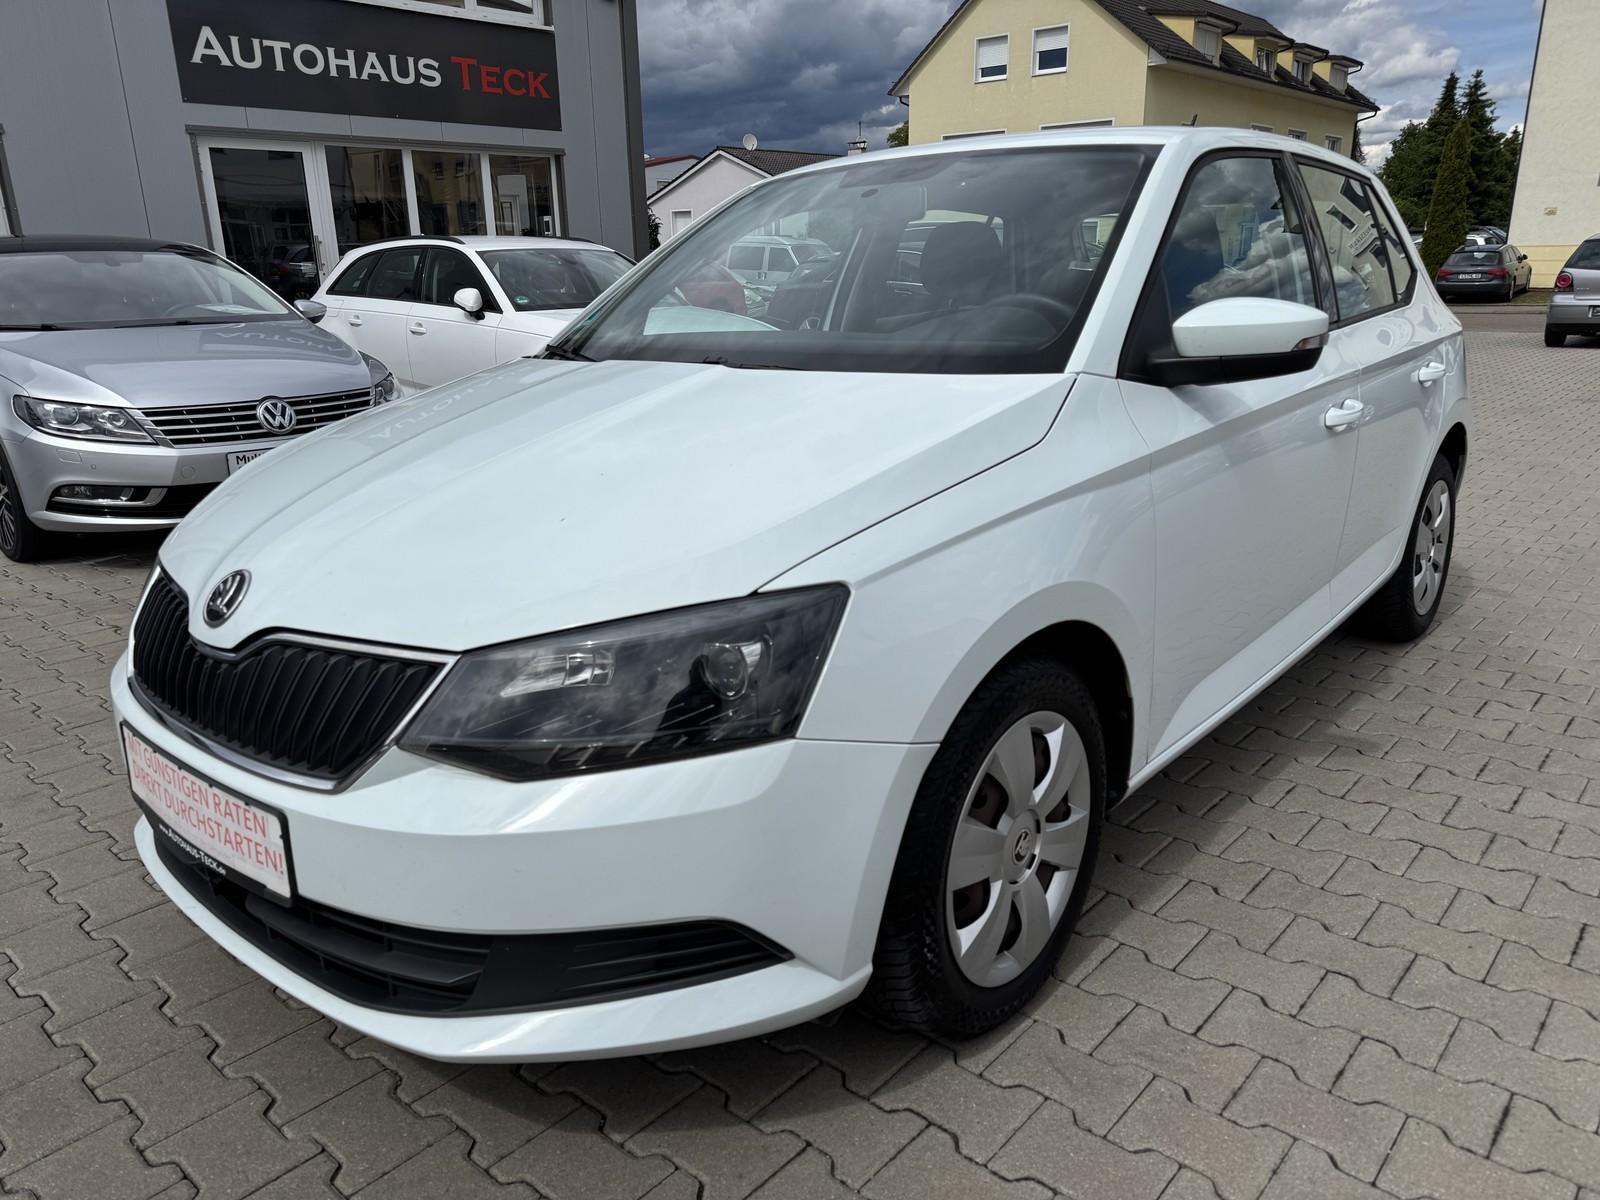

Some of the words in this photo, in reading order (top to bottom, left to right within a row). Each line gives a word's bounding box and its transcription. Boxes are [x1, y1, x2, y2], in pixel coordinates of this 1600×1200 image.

[190, 25, 442, 87] AUTOHAUS
[451, 56, 551, 99] TECK
[259, 400, 295, 432] VW
[133, 760, 161, 802] DIREKT
[164, 788, 284, 875] DURCHSTARTEN!
[213, 792, 267, 838] RATEN
